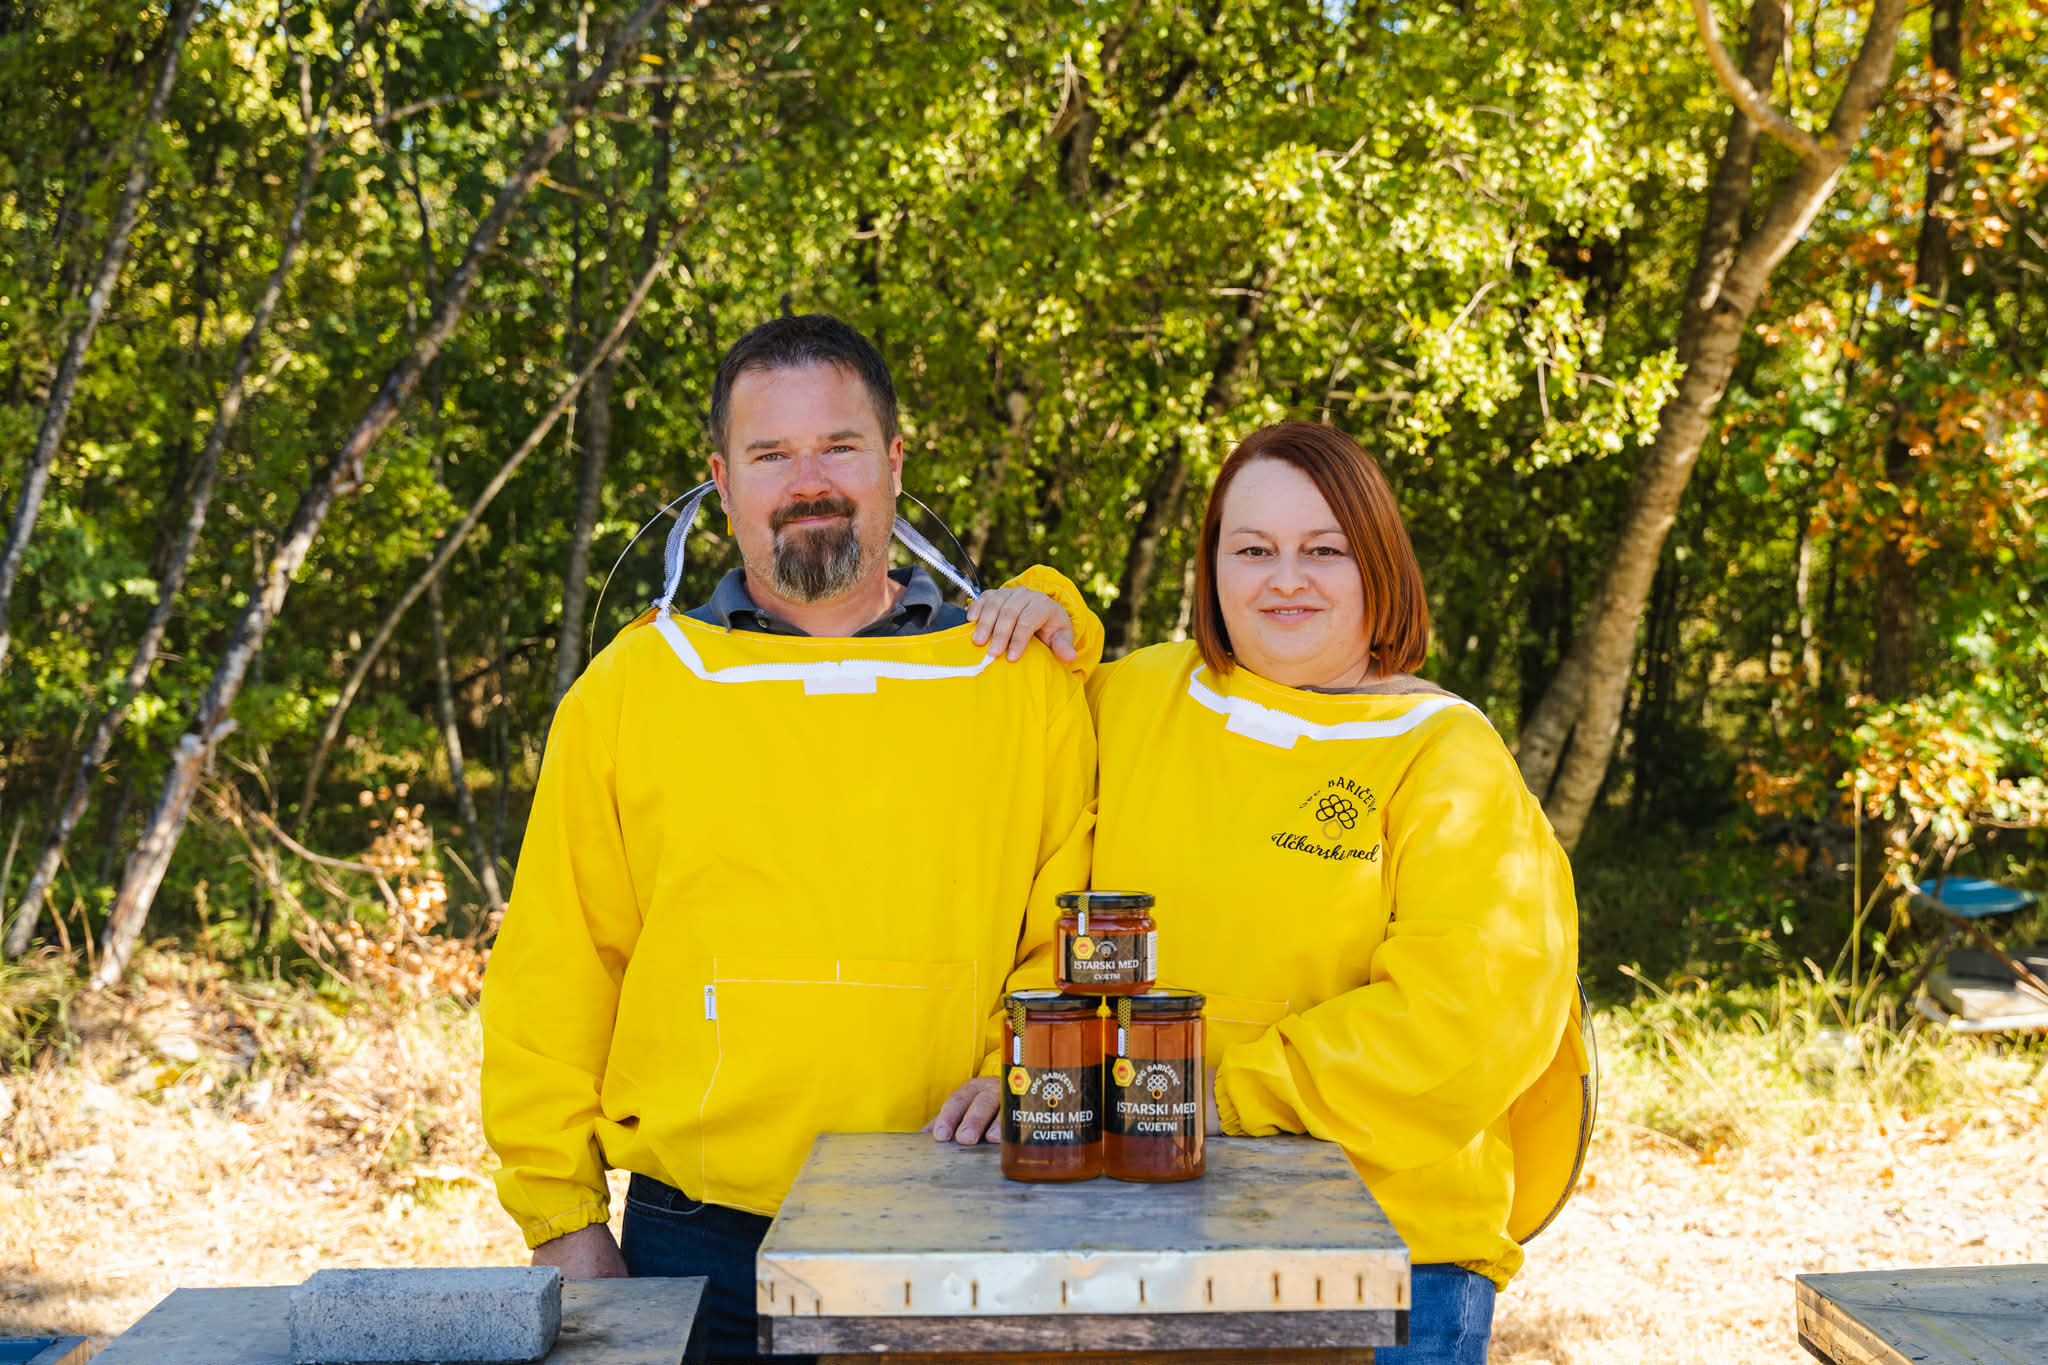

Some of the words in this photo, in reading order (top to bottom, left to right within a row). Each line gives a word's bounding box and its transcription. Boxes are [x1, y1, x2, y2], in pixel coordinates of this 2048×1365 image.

[1074, 960, 1115, 970] ISTARSKI
[1119, 959, 1139, 969] MED
[1117, 1101, 1168, 1116] ISTARSKI
[1172, 1102, 1197, 1114] MED
[1012, 1109, 1064, 1124] ISTARSKI
[1068, 1110, 1093, 1123] MED
[1137, 1121, 1178, 1132] CVJETNI
[1033, 1131, 1074, 1140] CVJETNI
